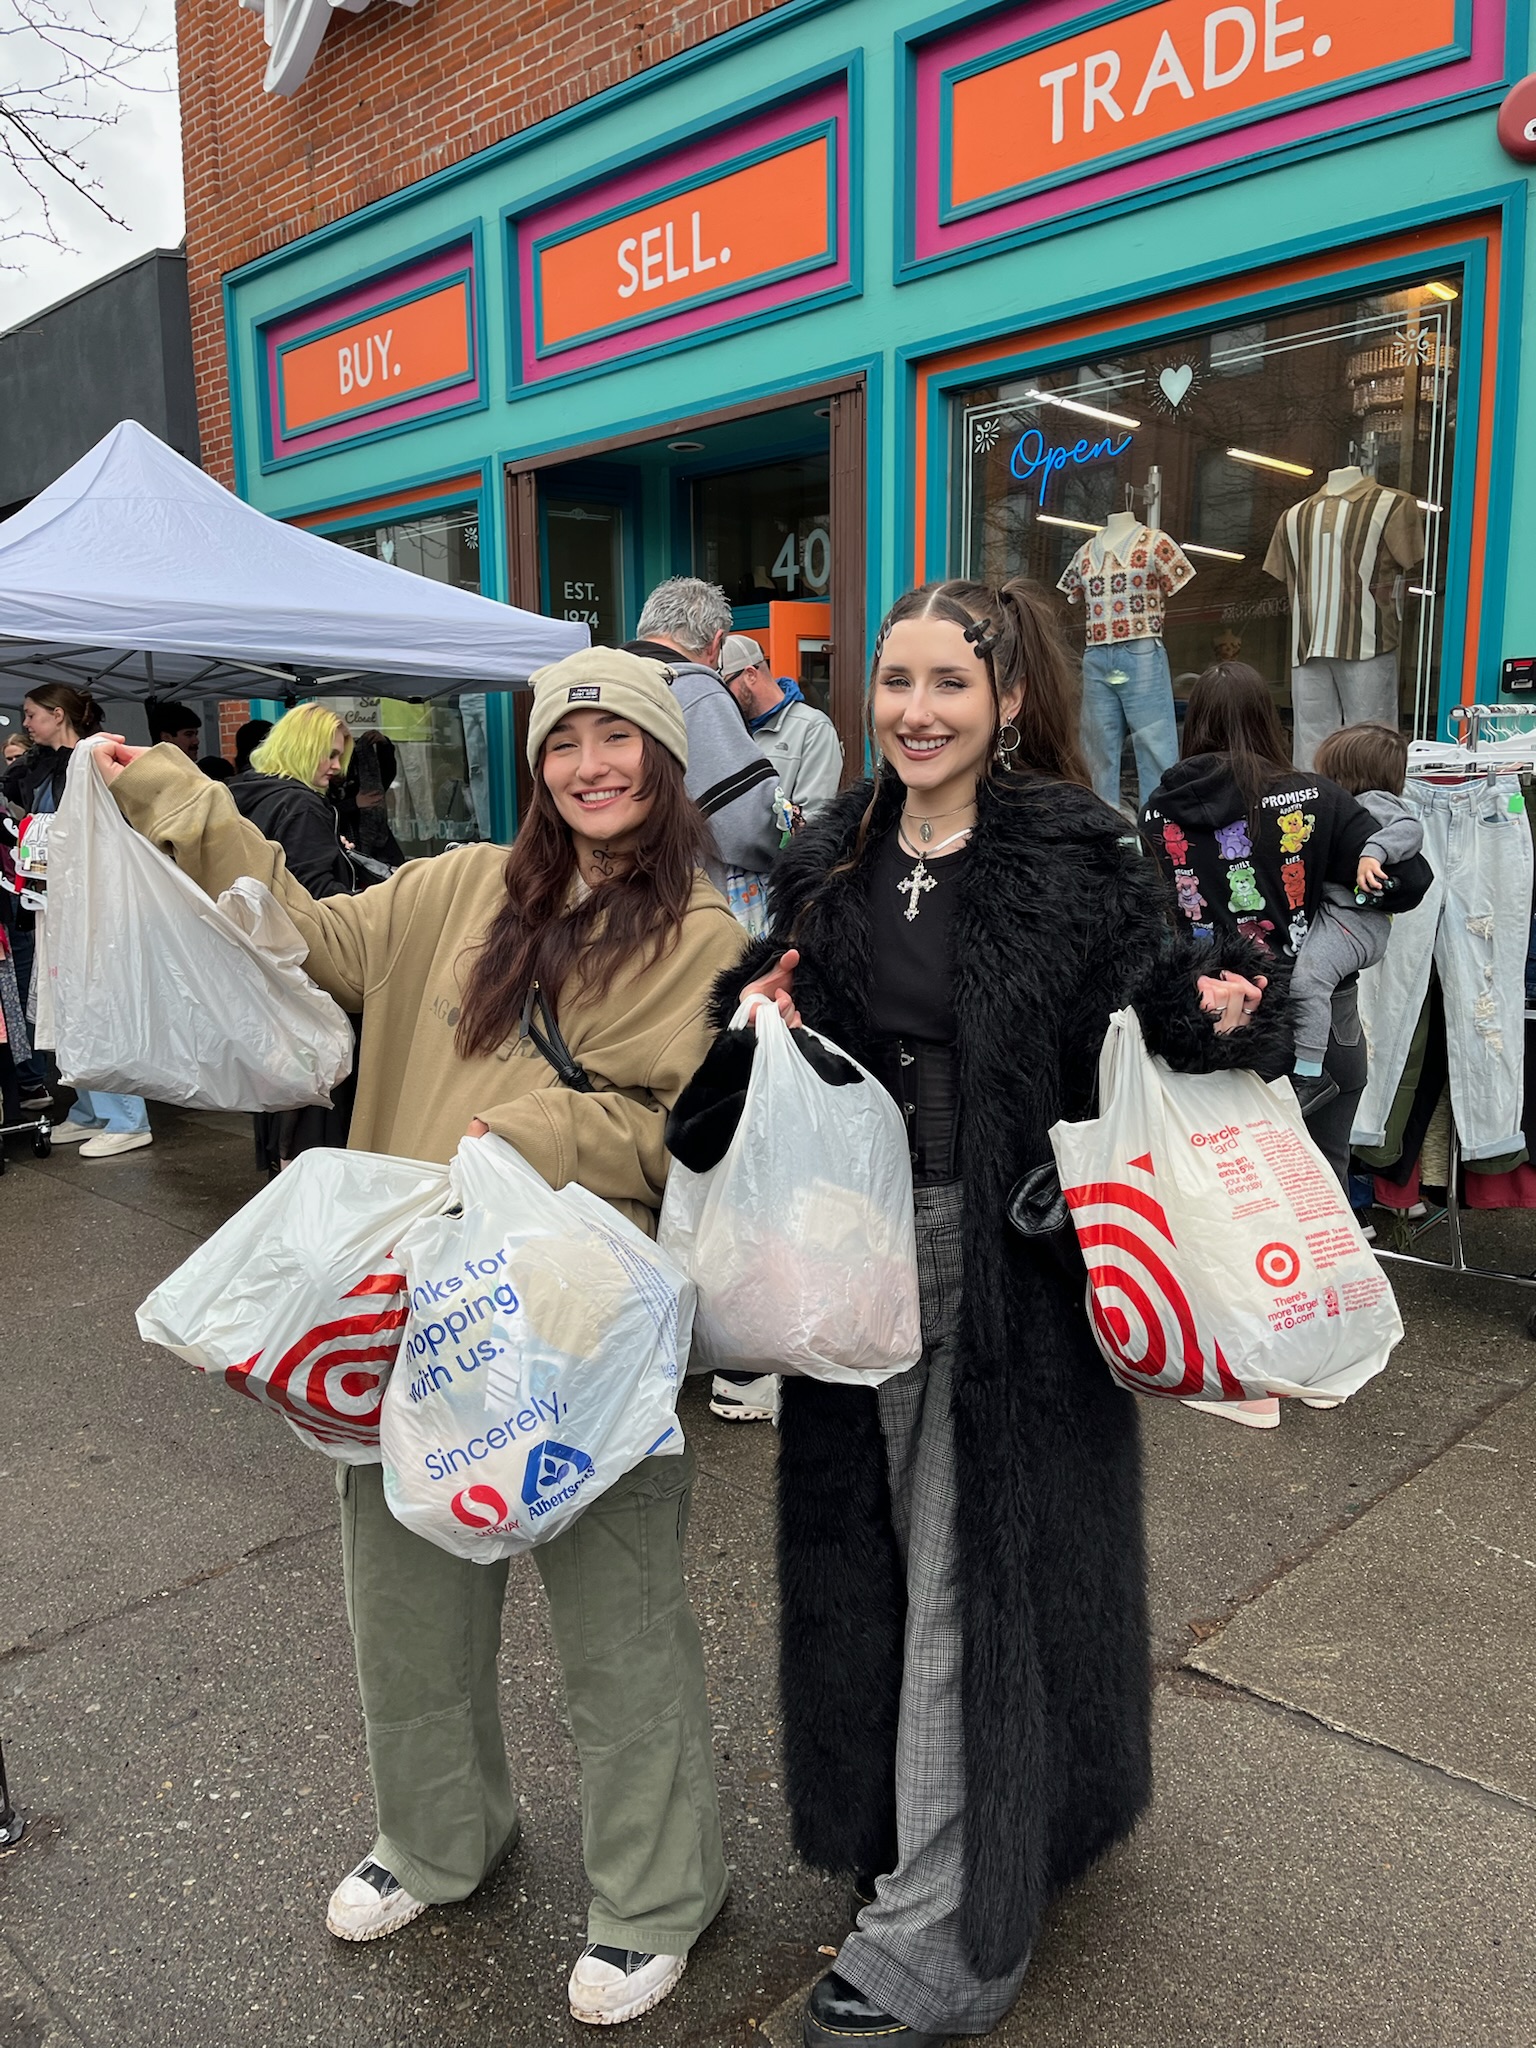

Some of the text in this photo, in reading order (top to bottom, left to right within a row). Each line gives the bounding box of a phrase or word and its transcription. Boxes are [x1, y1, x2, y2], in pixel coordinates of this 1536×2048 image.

[1039, 0, 1332, 144] TRADE.
[616, 210, 732, 299] SELL.
[337, 328, 401, 396] BUY.
[1010, 429, 1133, 507] Open
[771, 527, 831, 593] 40
[563, 581, 600, 601] EST.
[563, 609, 600, 629] 1974
[1261, 787, 1320, 809] PROMISES
[1229, 859, 1250, 872] GUILT
[1285, 854, 1300, 865] LIES
[1234, 1155, 1248, 1166] an
[1222, 1177, 1241, 1189] your
[1227, 1180, 1264, 1196] everyday
[464, 1248, 508, 1281] for
[1273, 1290, 1308, 1309] There's
[1268, 1307, 1292, 1322] more
[1273, 1321, 1283, 1332] at
[409, 1339, 505, 1404] with us.
[425, 1391, 568, 1480] Sincerely,
